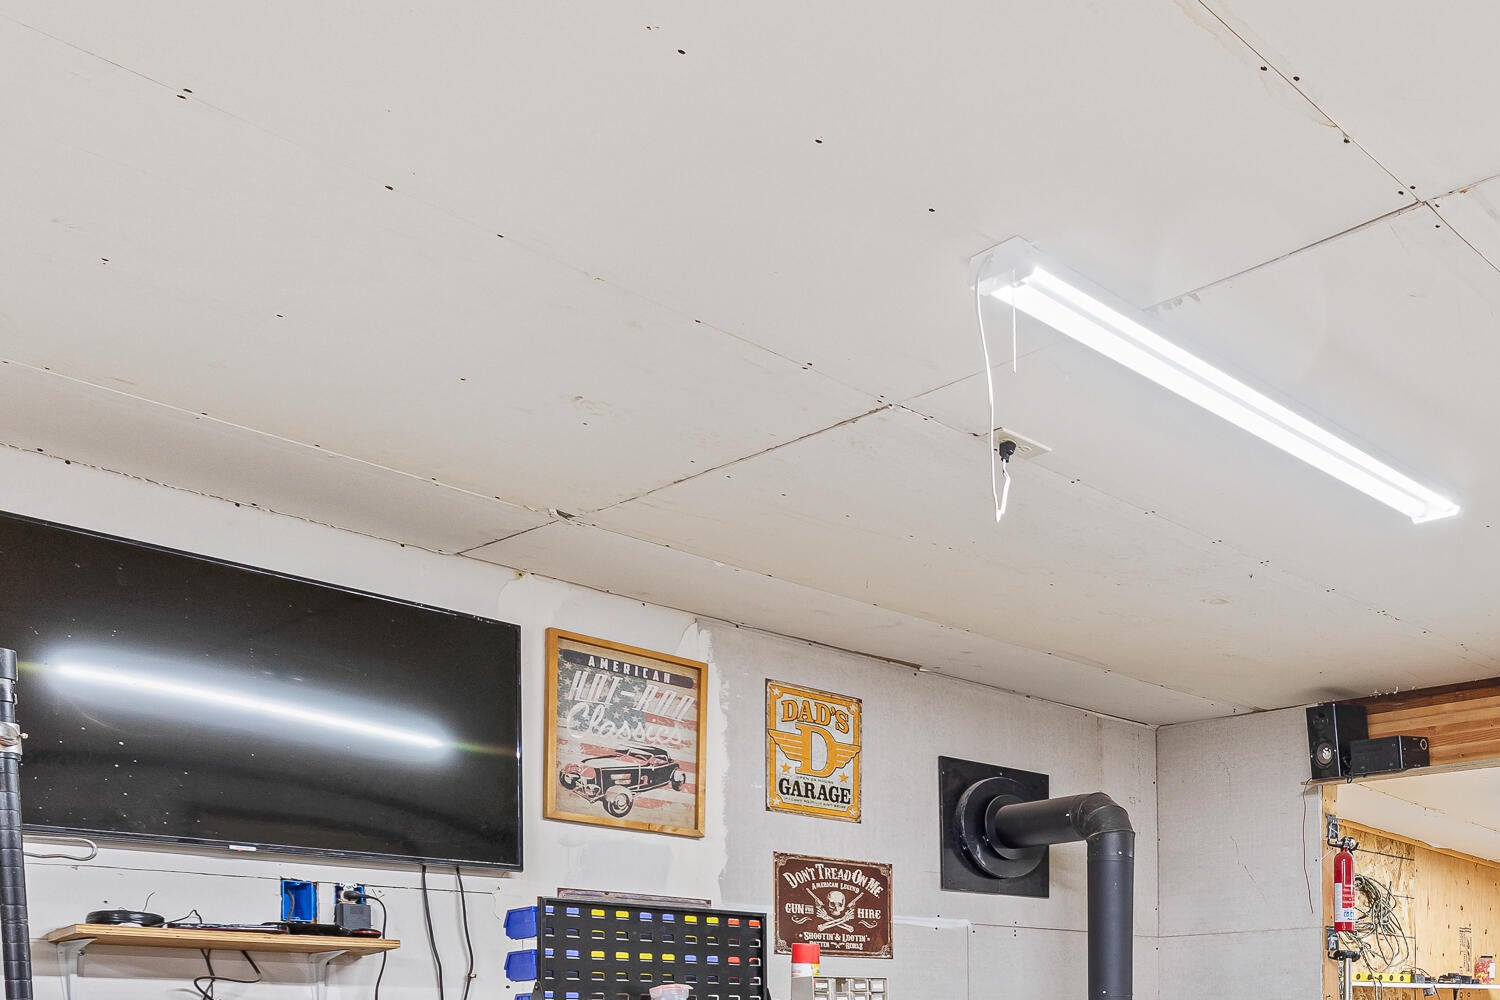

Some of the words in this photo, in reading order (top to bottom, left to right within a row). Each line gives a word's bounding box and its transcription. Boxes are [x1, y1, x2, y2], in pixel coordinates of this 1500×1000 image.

[588, 655, 671, 684] AMERICAN
[567, 702, 684, 745] Classics
[781, 700, 849, 734] DAD'S
[778, 777, 851, 805] GARAGE
[783, 866, 815, 889] DON'T
[815, 863, 852, 882] TREAD
[851, 869, 868, 888] ON
[866, 877, 884, 898] ME
[812, 881, 839, 890] AMERICAN
[840, 882, 860, 894] LEGEND
[785, 902, 804, 914] GUN
[857, 908, 881, 919] HIRE
